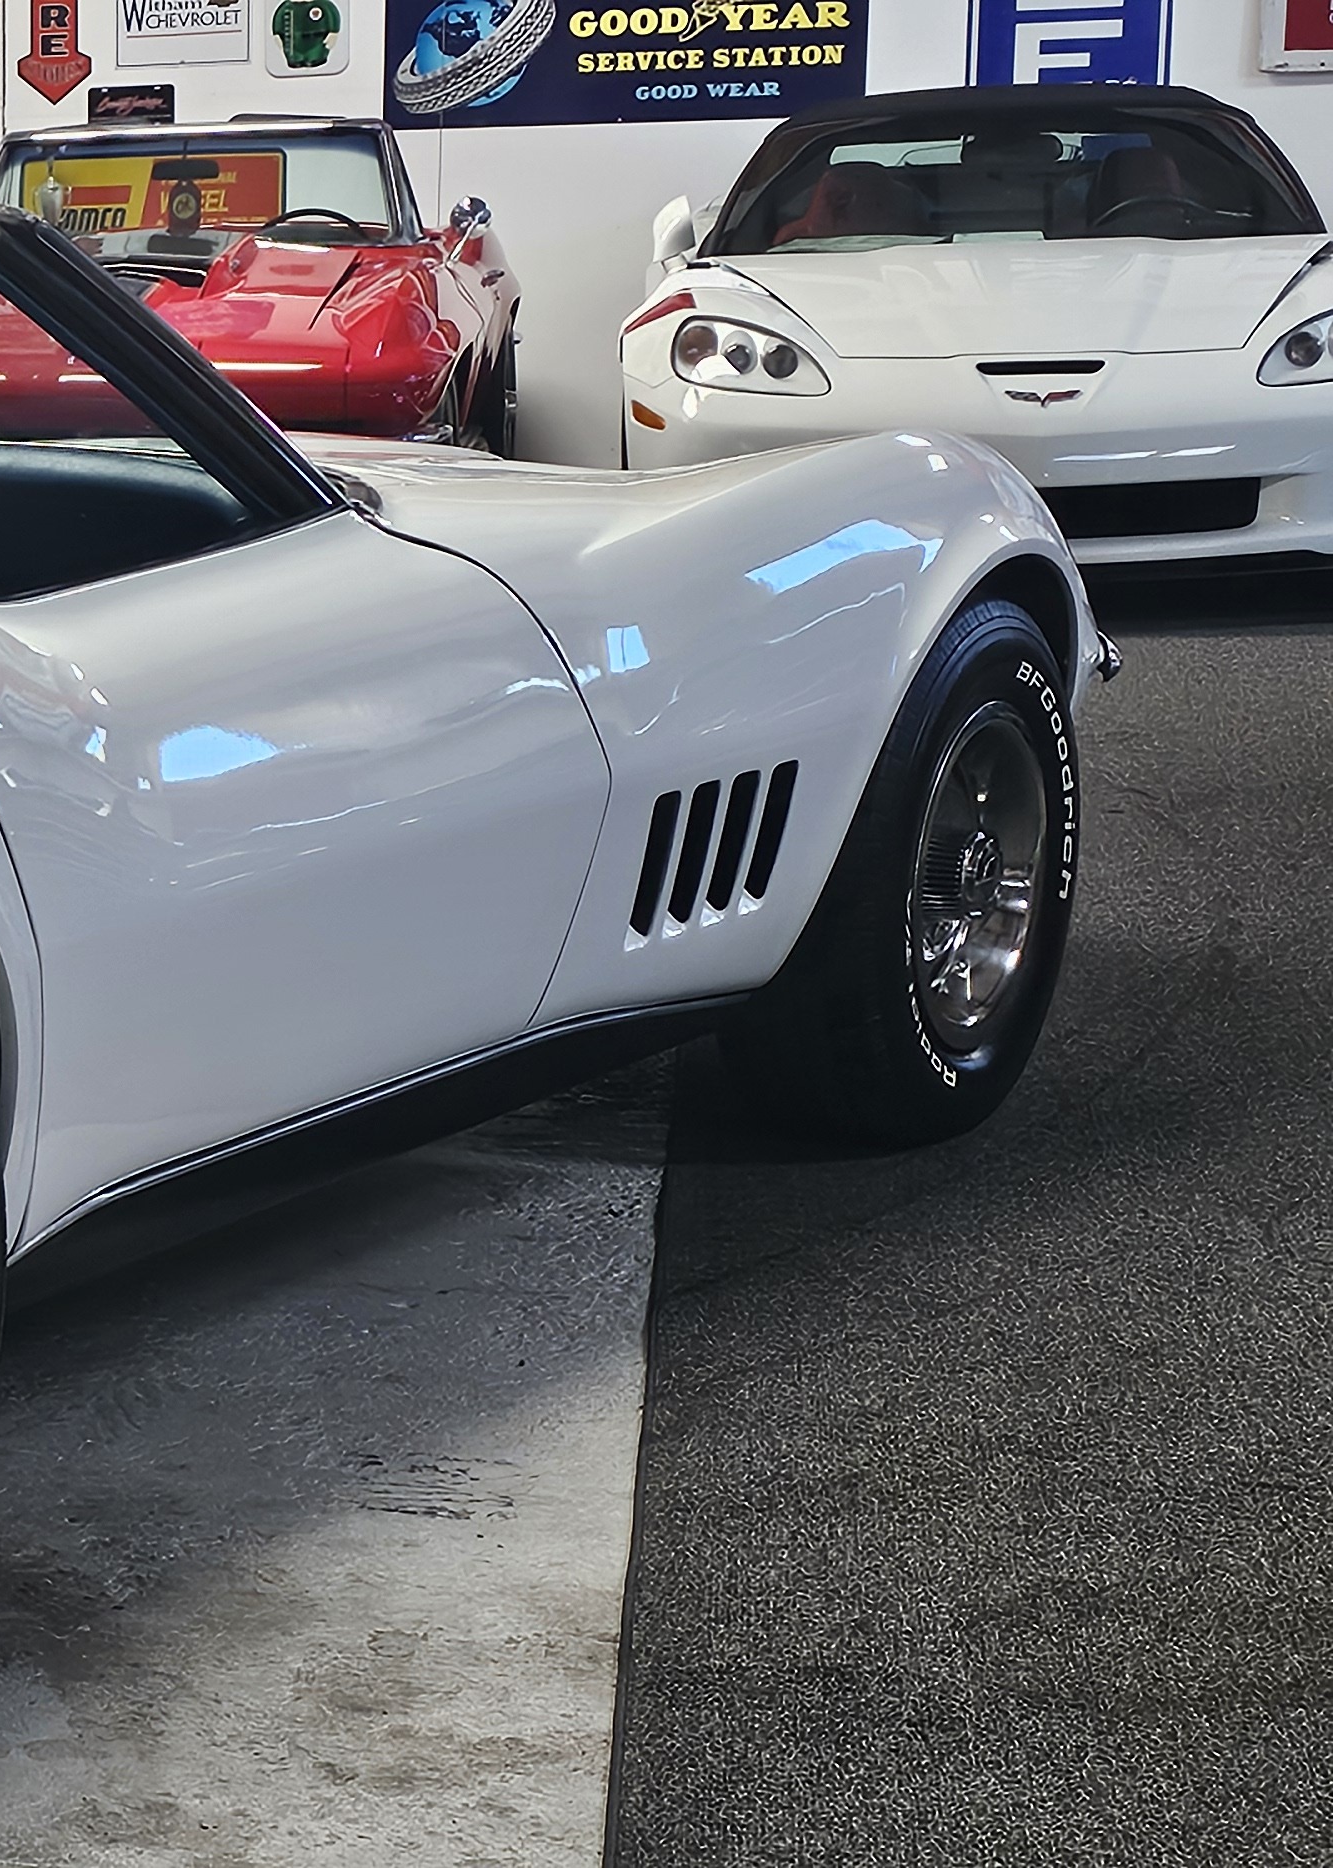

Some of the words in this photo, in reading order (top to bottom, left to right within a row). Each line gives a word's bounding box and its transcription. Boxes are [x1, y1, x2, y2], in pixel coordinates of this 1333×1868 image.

[145, 9, 242, 29] CHEVROLET
[577, 50, 704, 73] SERVICE
[713, 44, 845, 68] STATION
[635, 84, 698, 101] GOOD
[706, 81, 781, 97] WEAR
[1015, 661, 1076, 900] BFGoodrich
